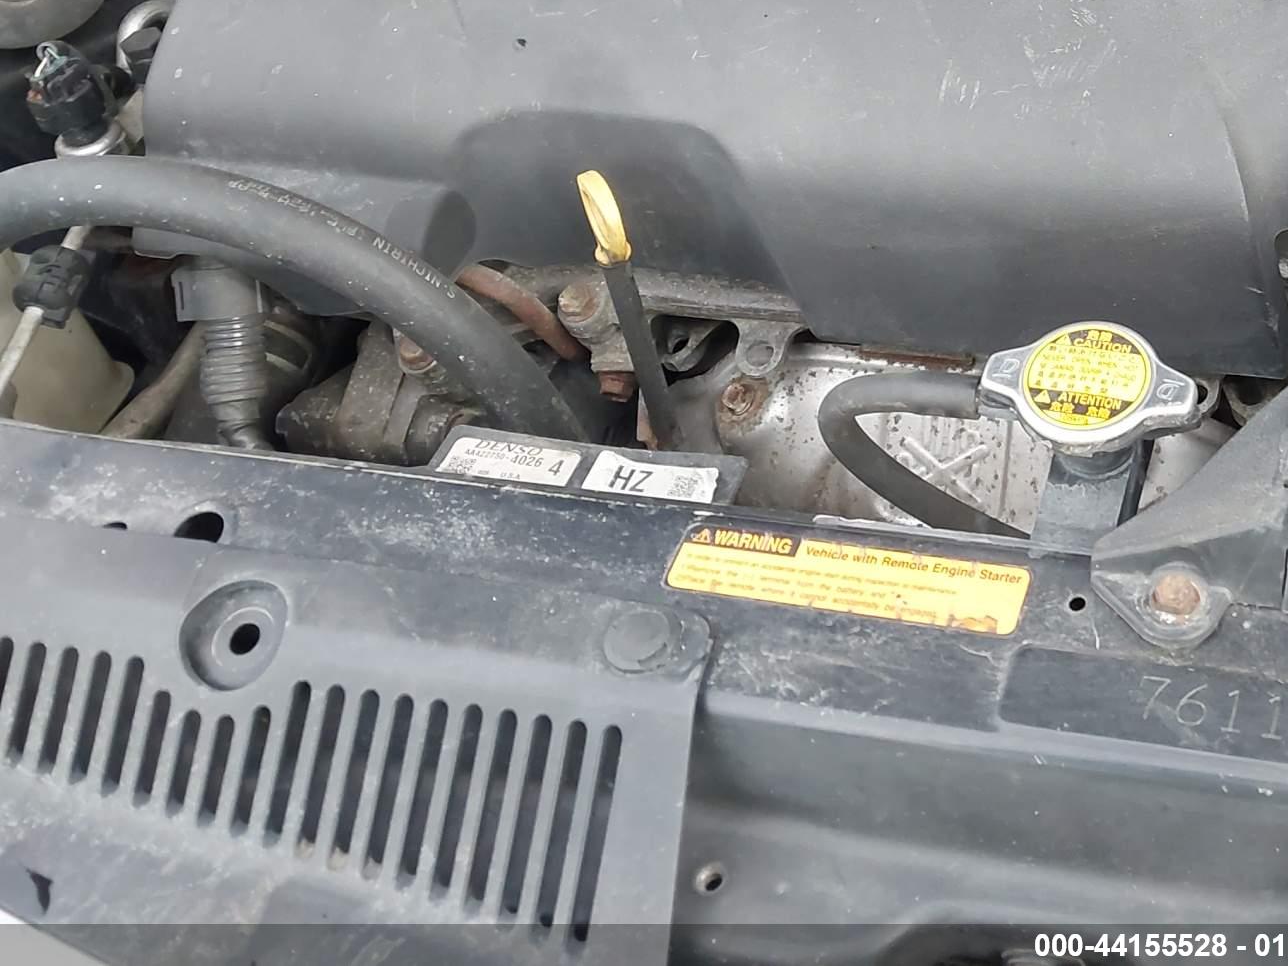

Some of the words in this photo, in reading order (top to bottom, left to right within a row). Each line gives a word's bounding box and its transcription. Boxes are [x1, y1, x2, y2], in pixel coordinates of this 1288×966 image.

[1073, 338, 1132, 354] CAUTION
[1057, 390, 1122, 410] ATTENTION
[475, 439, 543, 456] DENSO
[547, 458, 565, 476] 4
[609, 465, 654, 493] HZ
[714, 529, 793, 555] WARNING
[806, 545, 849, 561] Vehicle
[852, 552, 878, 565] with
[882, 556, 929, 572] Remote
[932, 563, 976, 579] Engine
[979, 569, 1024, 585] Starter
